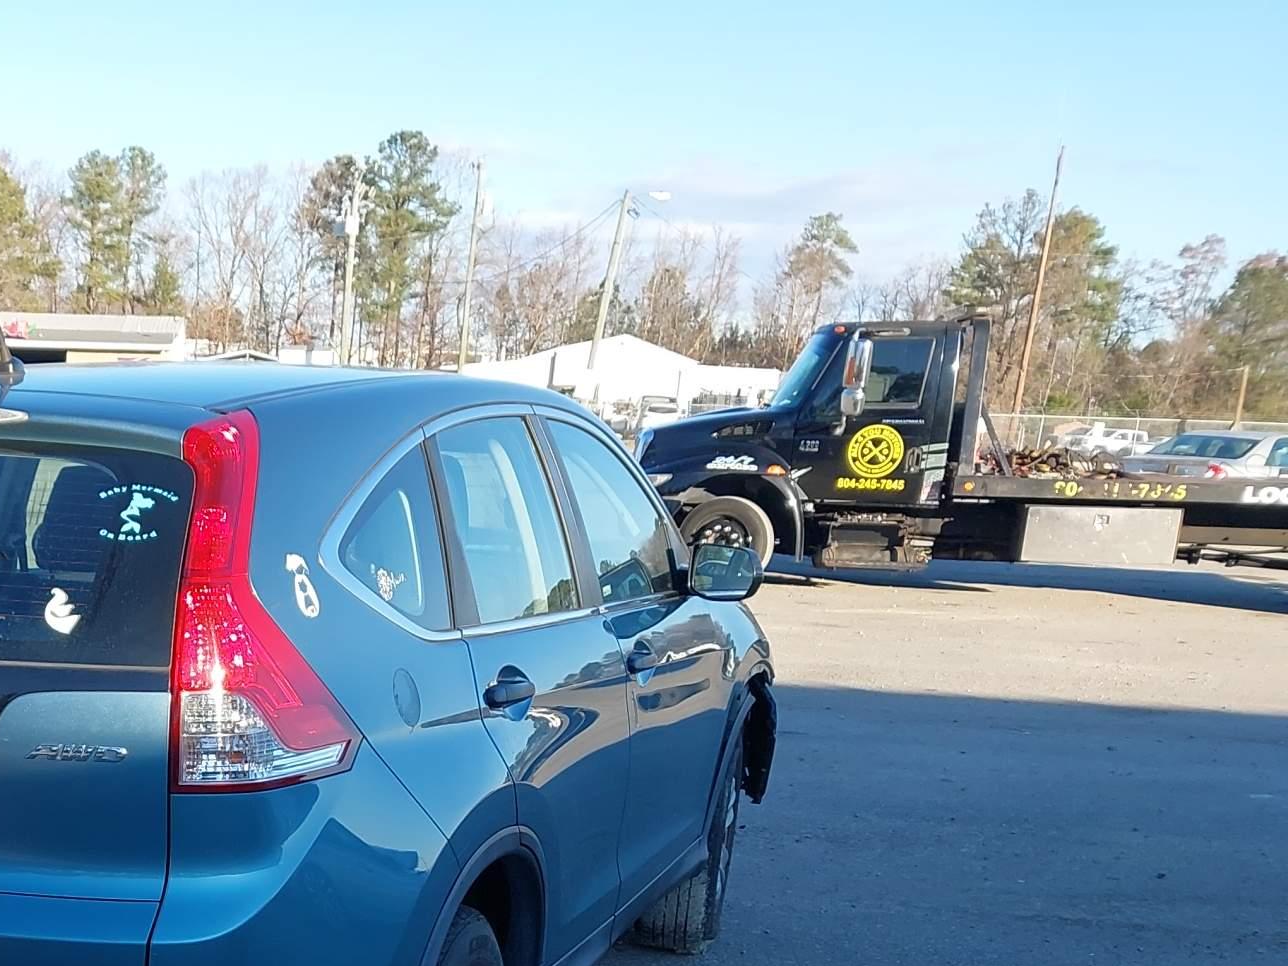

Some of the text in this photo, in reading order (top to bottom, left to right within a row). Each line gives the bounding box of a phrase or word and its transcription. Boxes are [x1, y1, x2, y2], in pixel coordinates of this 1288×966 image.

[837, 477, 906, 491] 804-245-7845
[99, 484, 180, 502] Baby Mermaid
[99, 528, 158, 541] On Board
[24, 743, 129, 763] AWD
